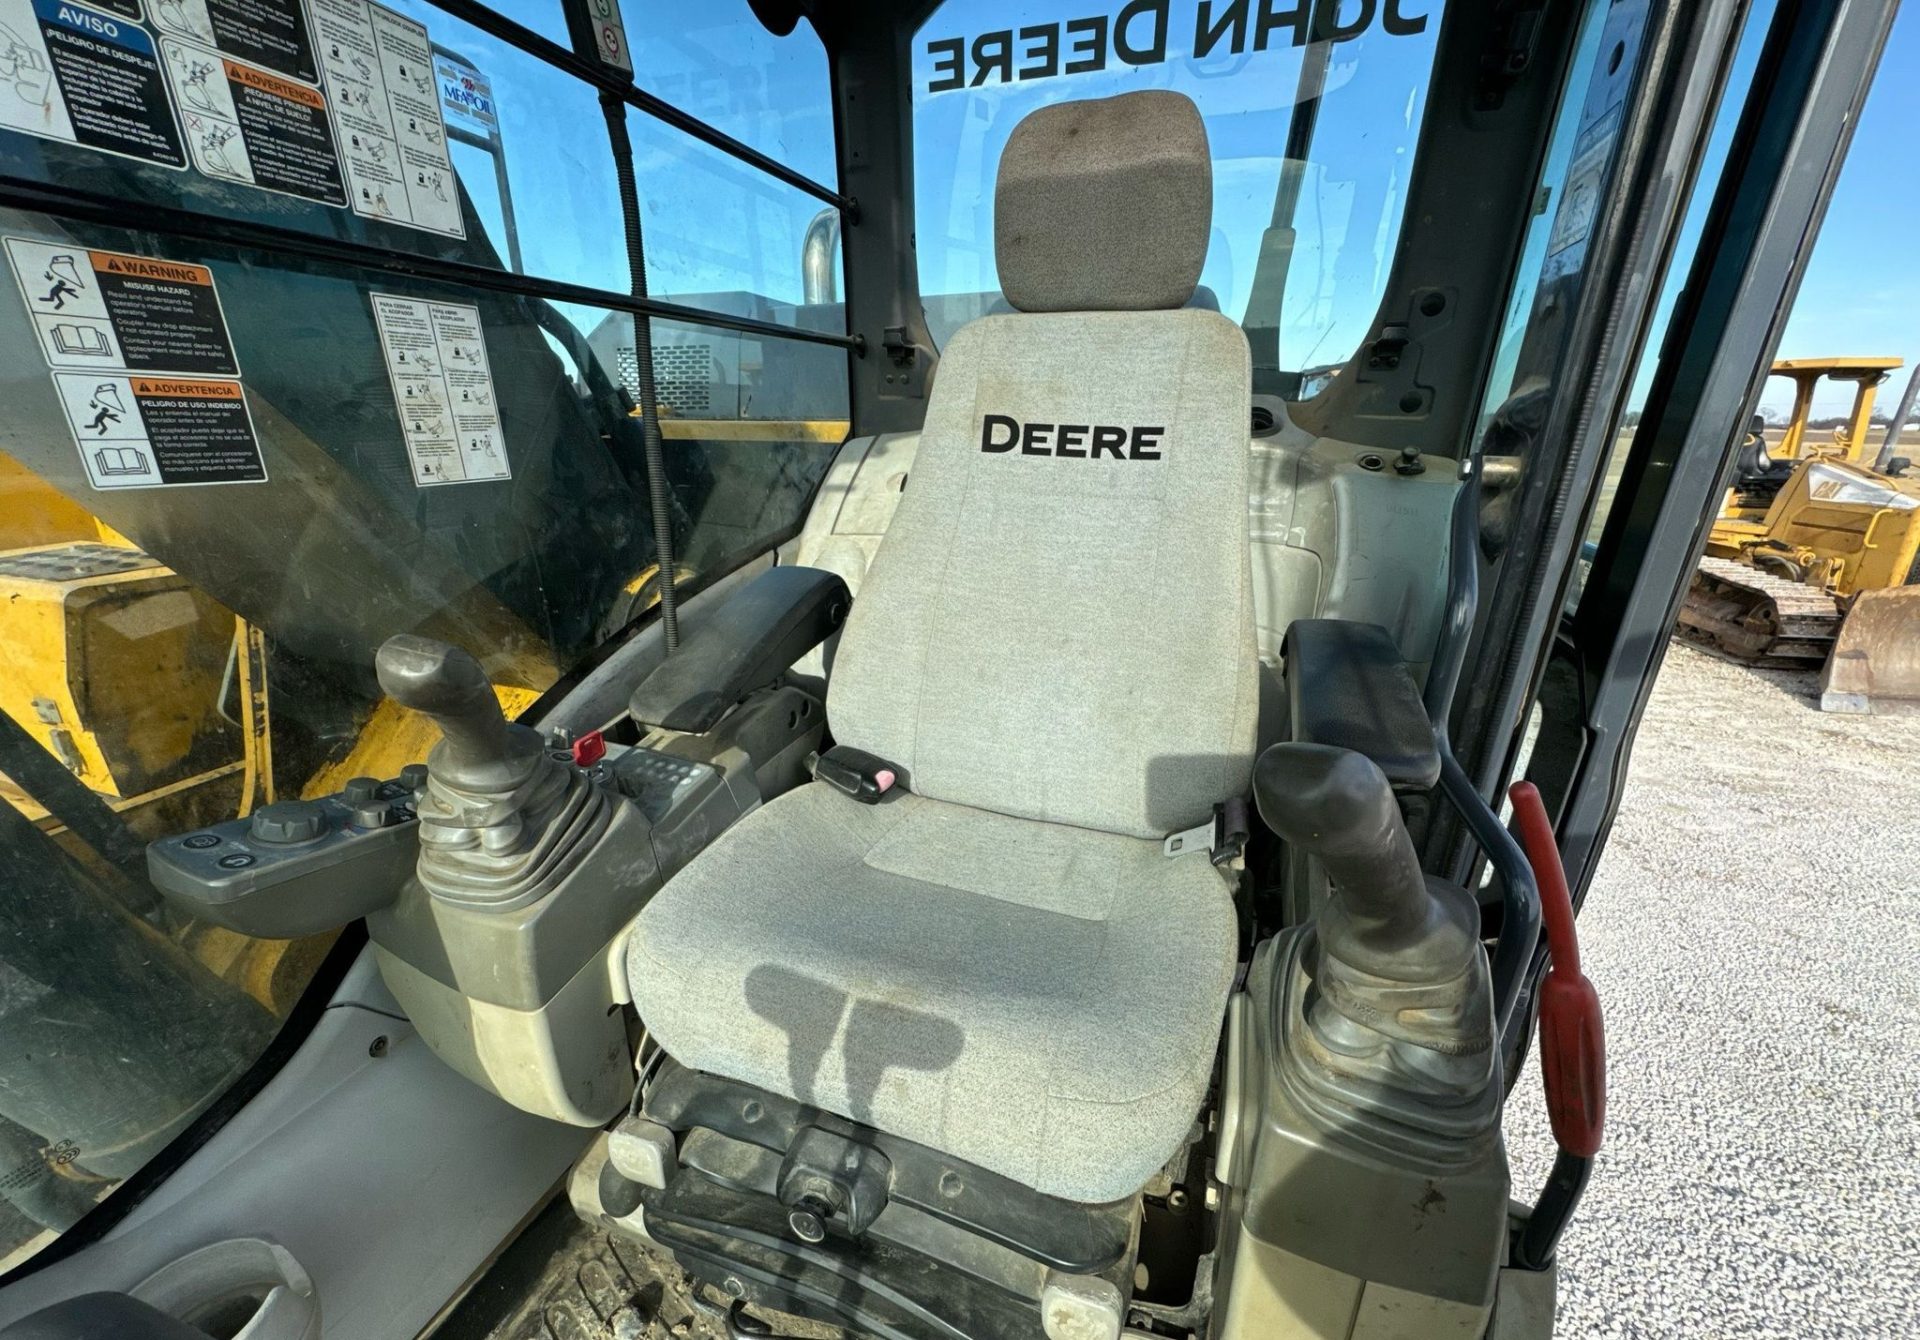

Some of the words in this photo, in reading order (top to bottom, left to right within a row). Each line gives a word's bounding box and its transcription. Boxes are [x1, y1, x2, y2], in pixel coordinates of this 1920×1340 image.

[59, 7, 118, 37] AVISO
[96, 45, 111, 56] DE
[111, 50, 157, 70] DESPEJE!
[245, 71, 319, 105] ADVERTENCIA
[444, 83, 469, 106] MFA
[123, 261, 197, 281] WARNING
[123, 282, 156, 291] MISUSE
[157, 286, 191, 295] HAZARD
[155, 384, 234, 395] ADVERTENCIA
[981, 414, 1165, 460] DEERE
[1812, 481, 1850, 499] CAT
